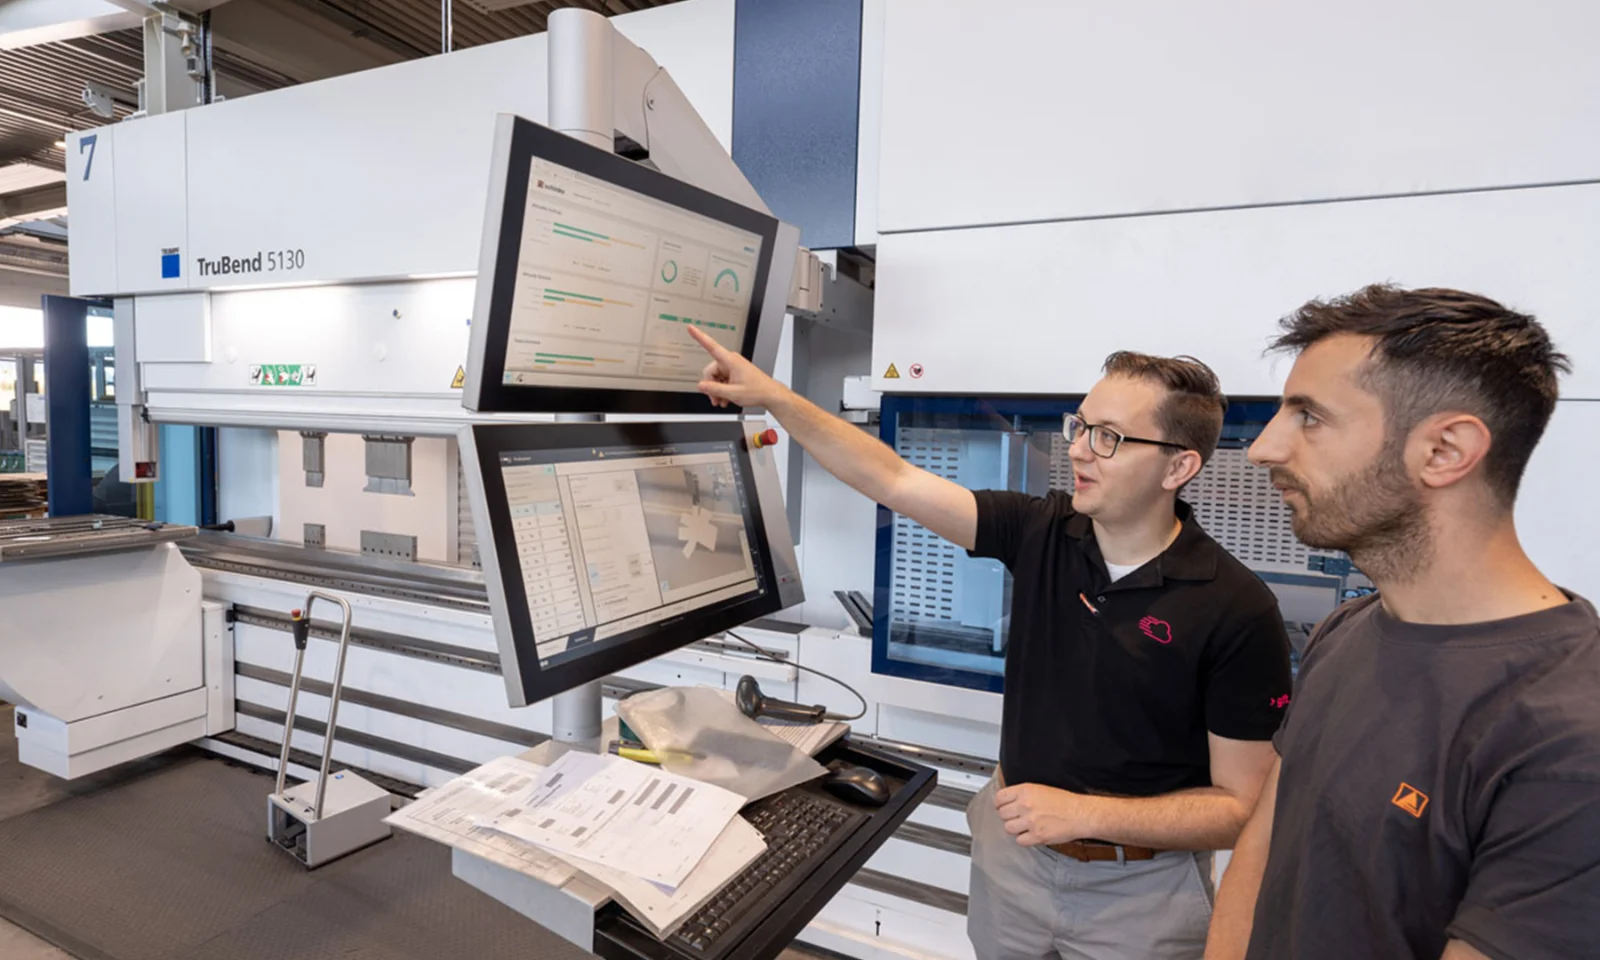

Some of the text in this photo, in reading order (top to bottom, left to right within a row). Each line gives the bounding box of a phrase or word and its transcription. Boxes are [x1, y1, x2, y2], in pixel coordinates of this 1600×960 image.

[79, 134, 98, 181] 7
[197, 249, 305, 277] TruBend 5130
